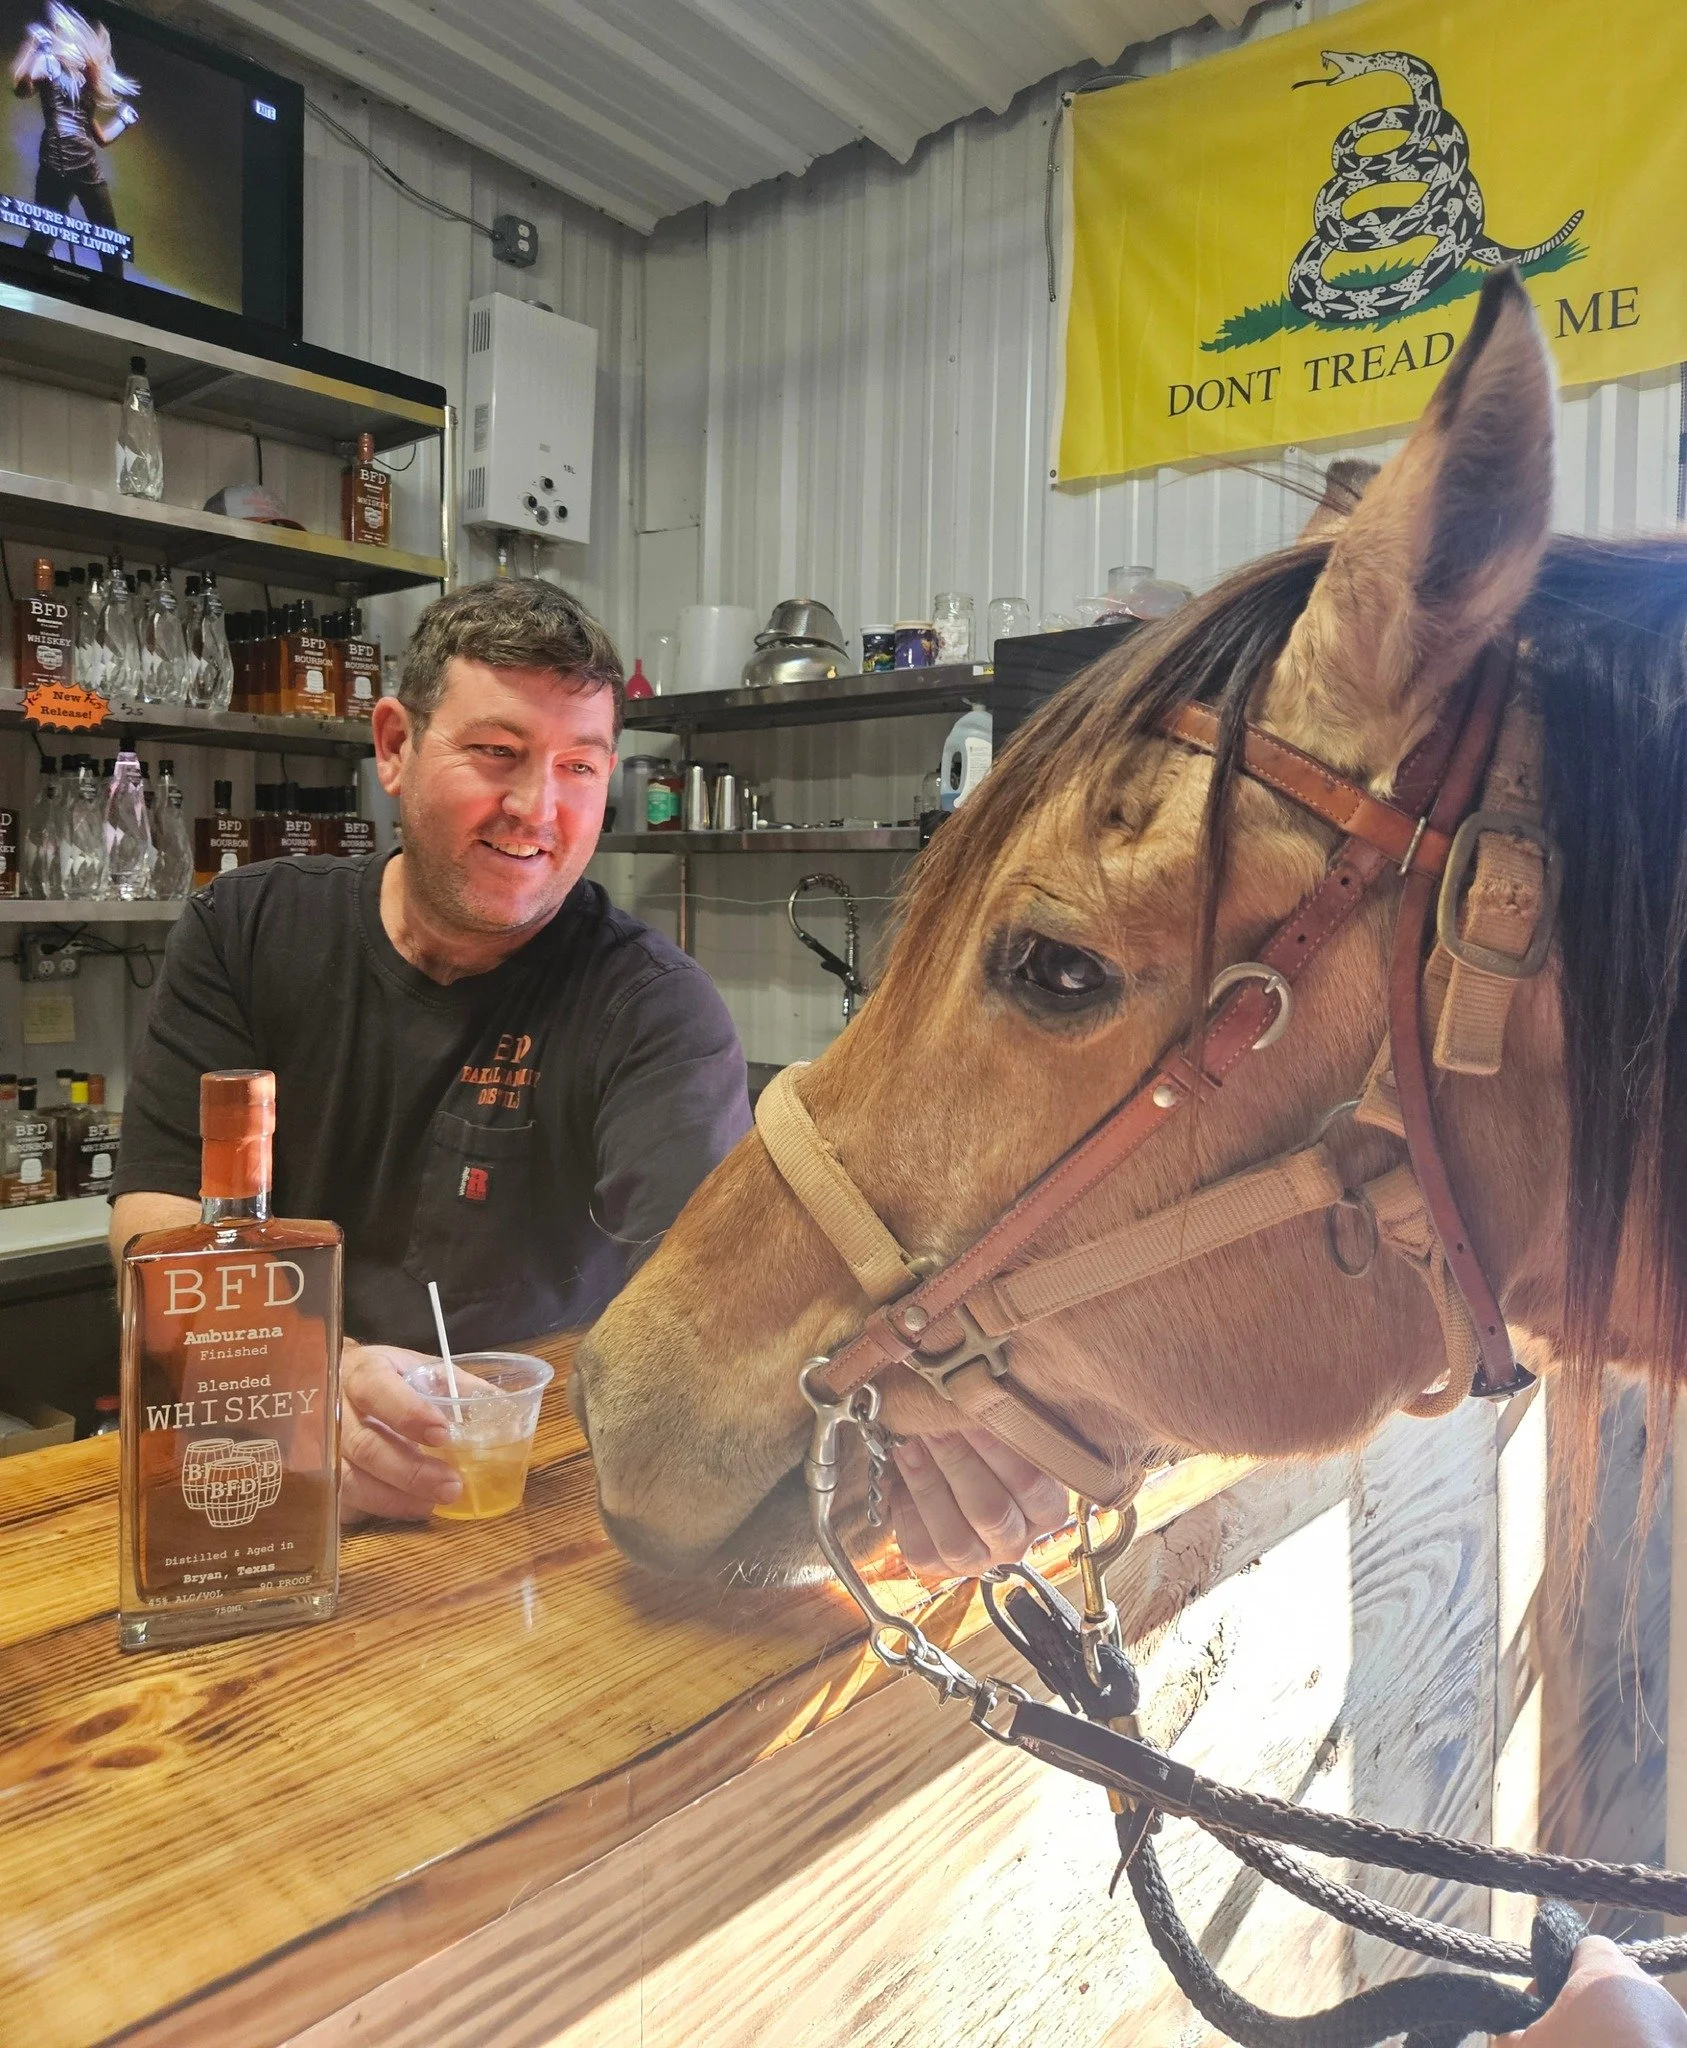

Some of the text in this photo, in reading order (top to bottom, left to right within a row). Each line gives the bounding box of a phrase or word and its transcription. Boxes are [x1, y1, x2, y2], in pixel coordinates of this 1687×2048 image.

[15, 199, 63, 225] YOU'RE
[65, 215, 92, 234] NOT
[31, 218, 79, 244] YOU'RE
[1168, 286, 1640, 417] DONT TREAD ME
[360, 469, 387, 485] BFD
[31, 601, 68, 618] BFD
[27, 634, 71, 647] WHISKEY
[301, 637, 326, 650] BFD
[348, 644, 374, 657] BFD
[294, 655, 333, 667] BOURBON
[344, 661, 379, 671] BOURBON
[52, 691, 81, 703] New
[40, 706, 92, 719] Release!
[218, 820, 241, 831] BFD
[285, 821, 311, 831] BFD
[345, 823, 369, 833] BFD
[210, 838, 248, 847] BOURBON
[281, 838, 317, 846] BOURBON
[15, 1123, 48, 1136] BFD
[163, 1260, 305, 1315] BFD
[183, 1326, 283, 1345] Amburana
[200, 1344, 268, 1361] Finished
[197, 1374, 271, 1393] Blended
[146, 1388, 319, 1432] WHISKEY
[210, 1478, 257, 1499] BFD
[165, 1551, 228, 1566] Distilled
[247, 1543, 275, 1556] Aged
[281, 1541, 294, 1551] in
[183, 1563, 276, 1585] Bryan, Texas
[260, 1575, 312, 1590] 90 PROOF
[175, 1589, 224, 1604] ALC/VOL
[213, 1604, 244, 1617] 750ML
